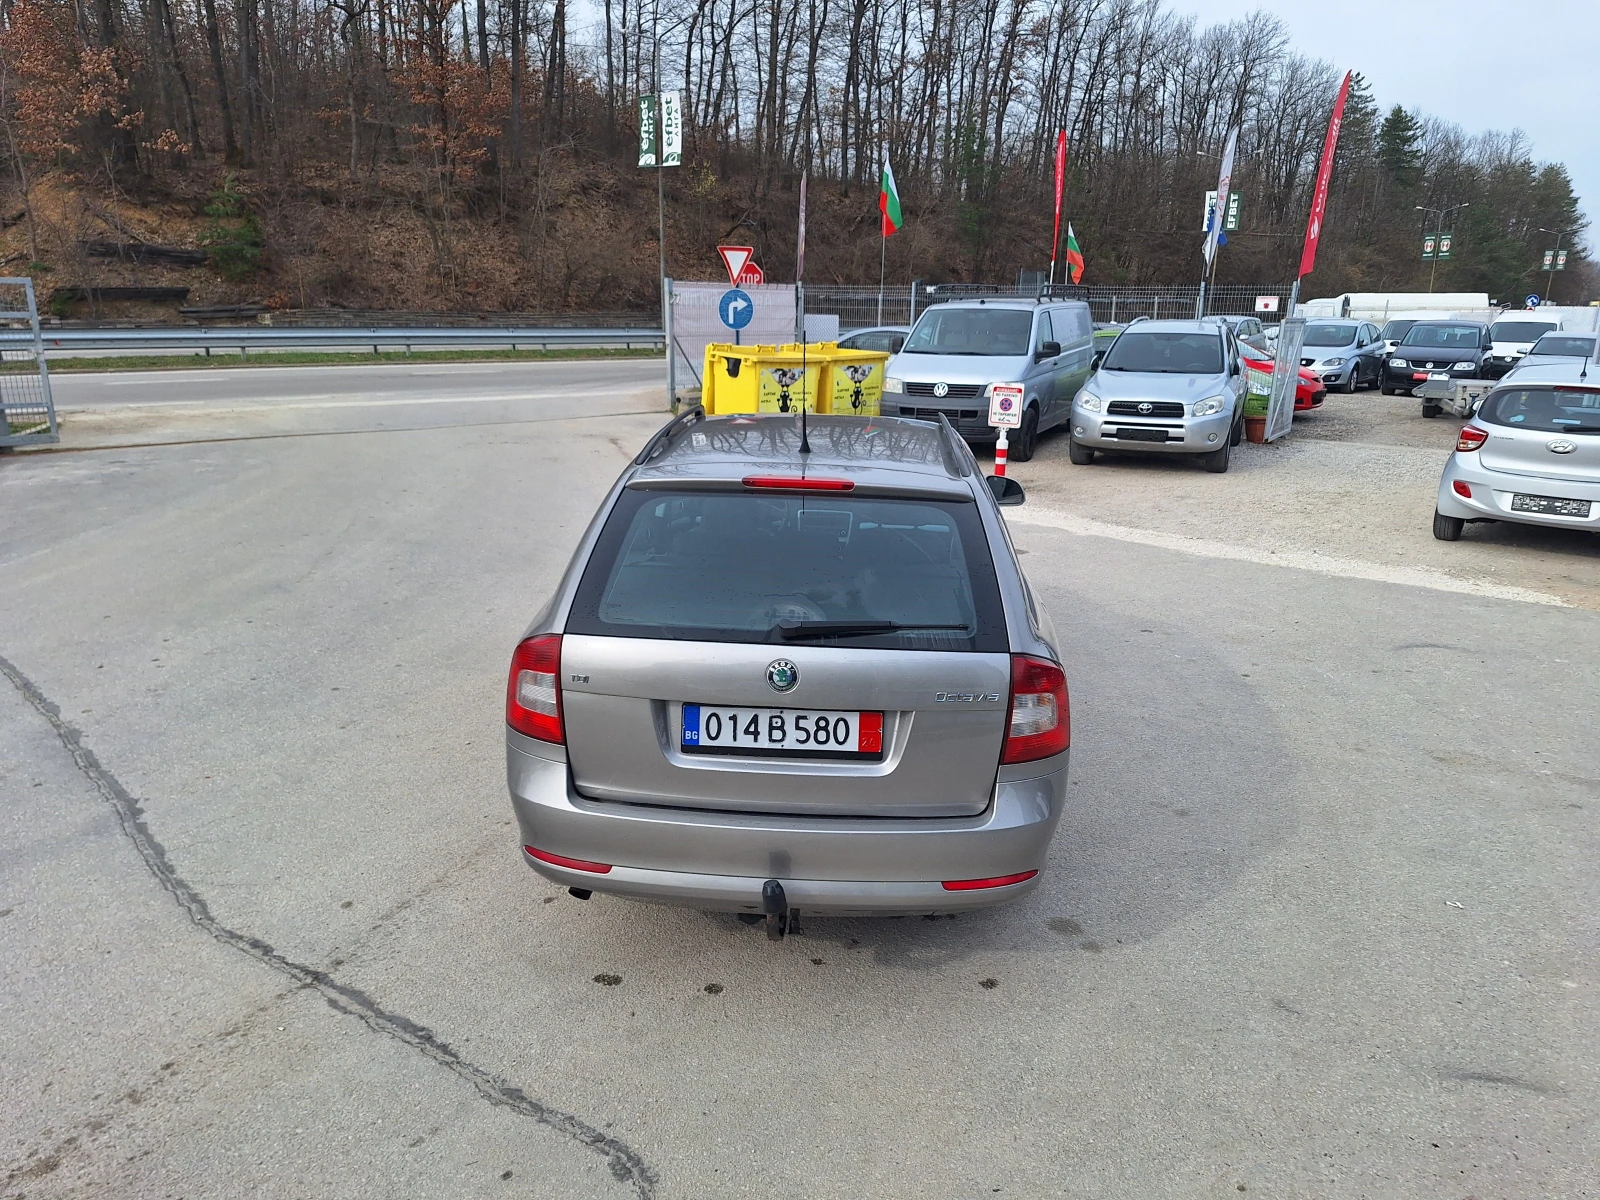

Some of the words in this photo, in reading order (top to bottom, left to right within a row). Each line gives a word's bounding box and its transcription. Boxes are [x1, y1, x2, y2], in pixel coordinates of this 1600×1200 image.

[640, 99, 649, 151] efbet
[665, 96, 674, 147] efbet
[1227, 193, 1239, 229] EFBET
[741, 273, 761, 285] TOP
[935, 691, 1000, 703] Octavia
[685, 731, 698, 740] BG
